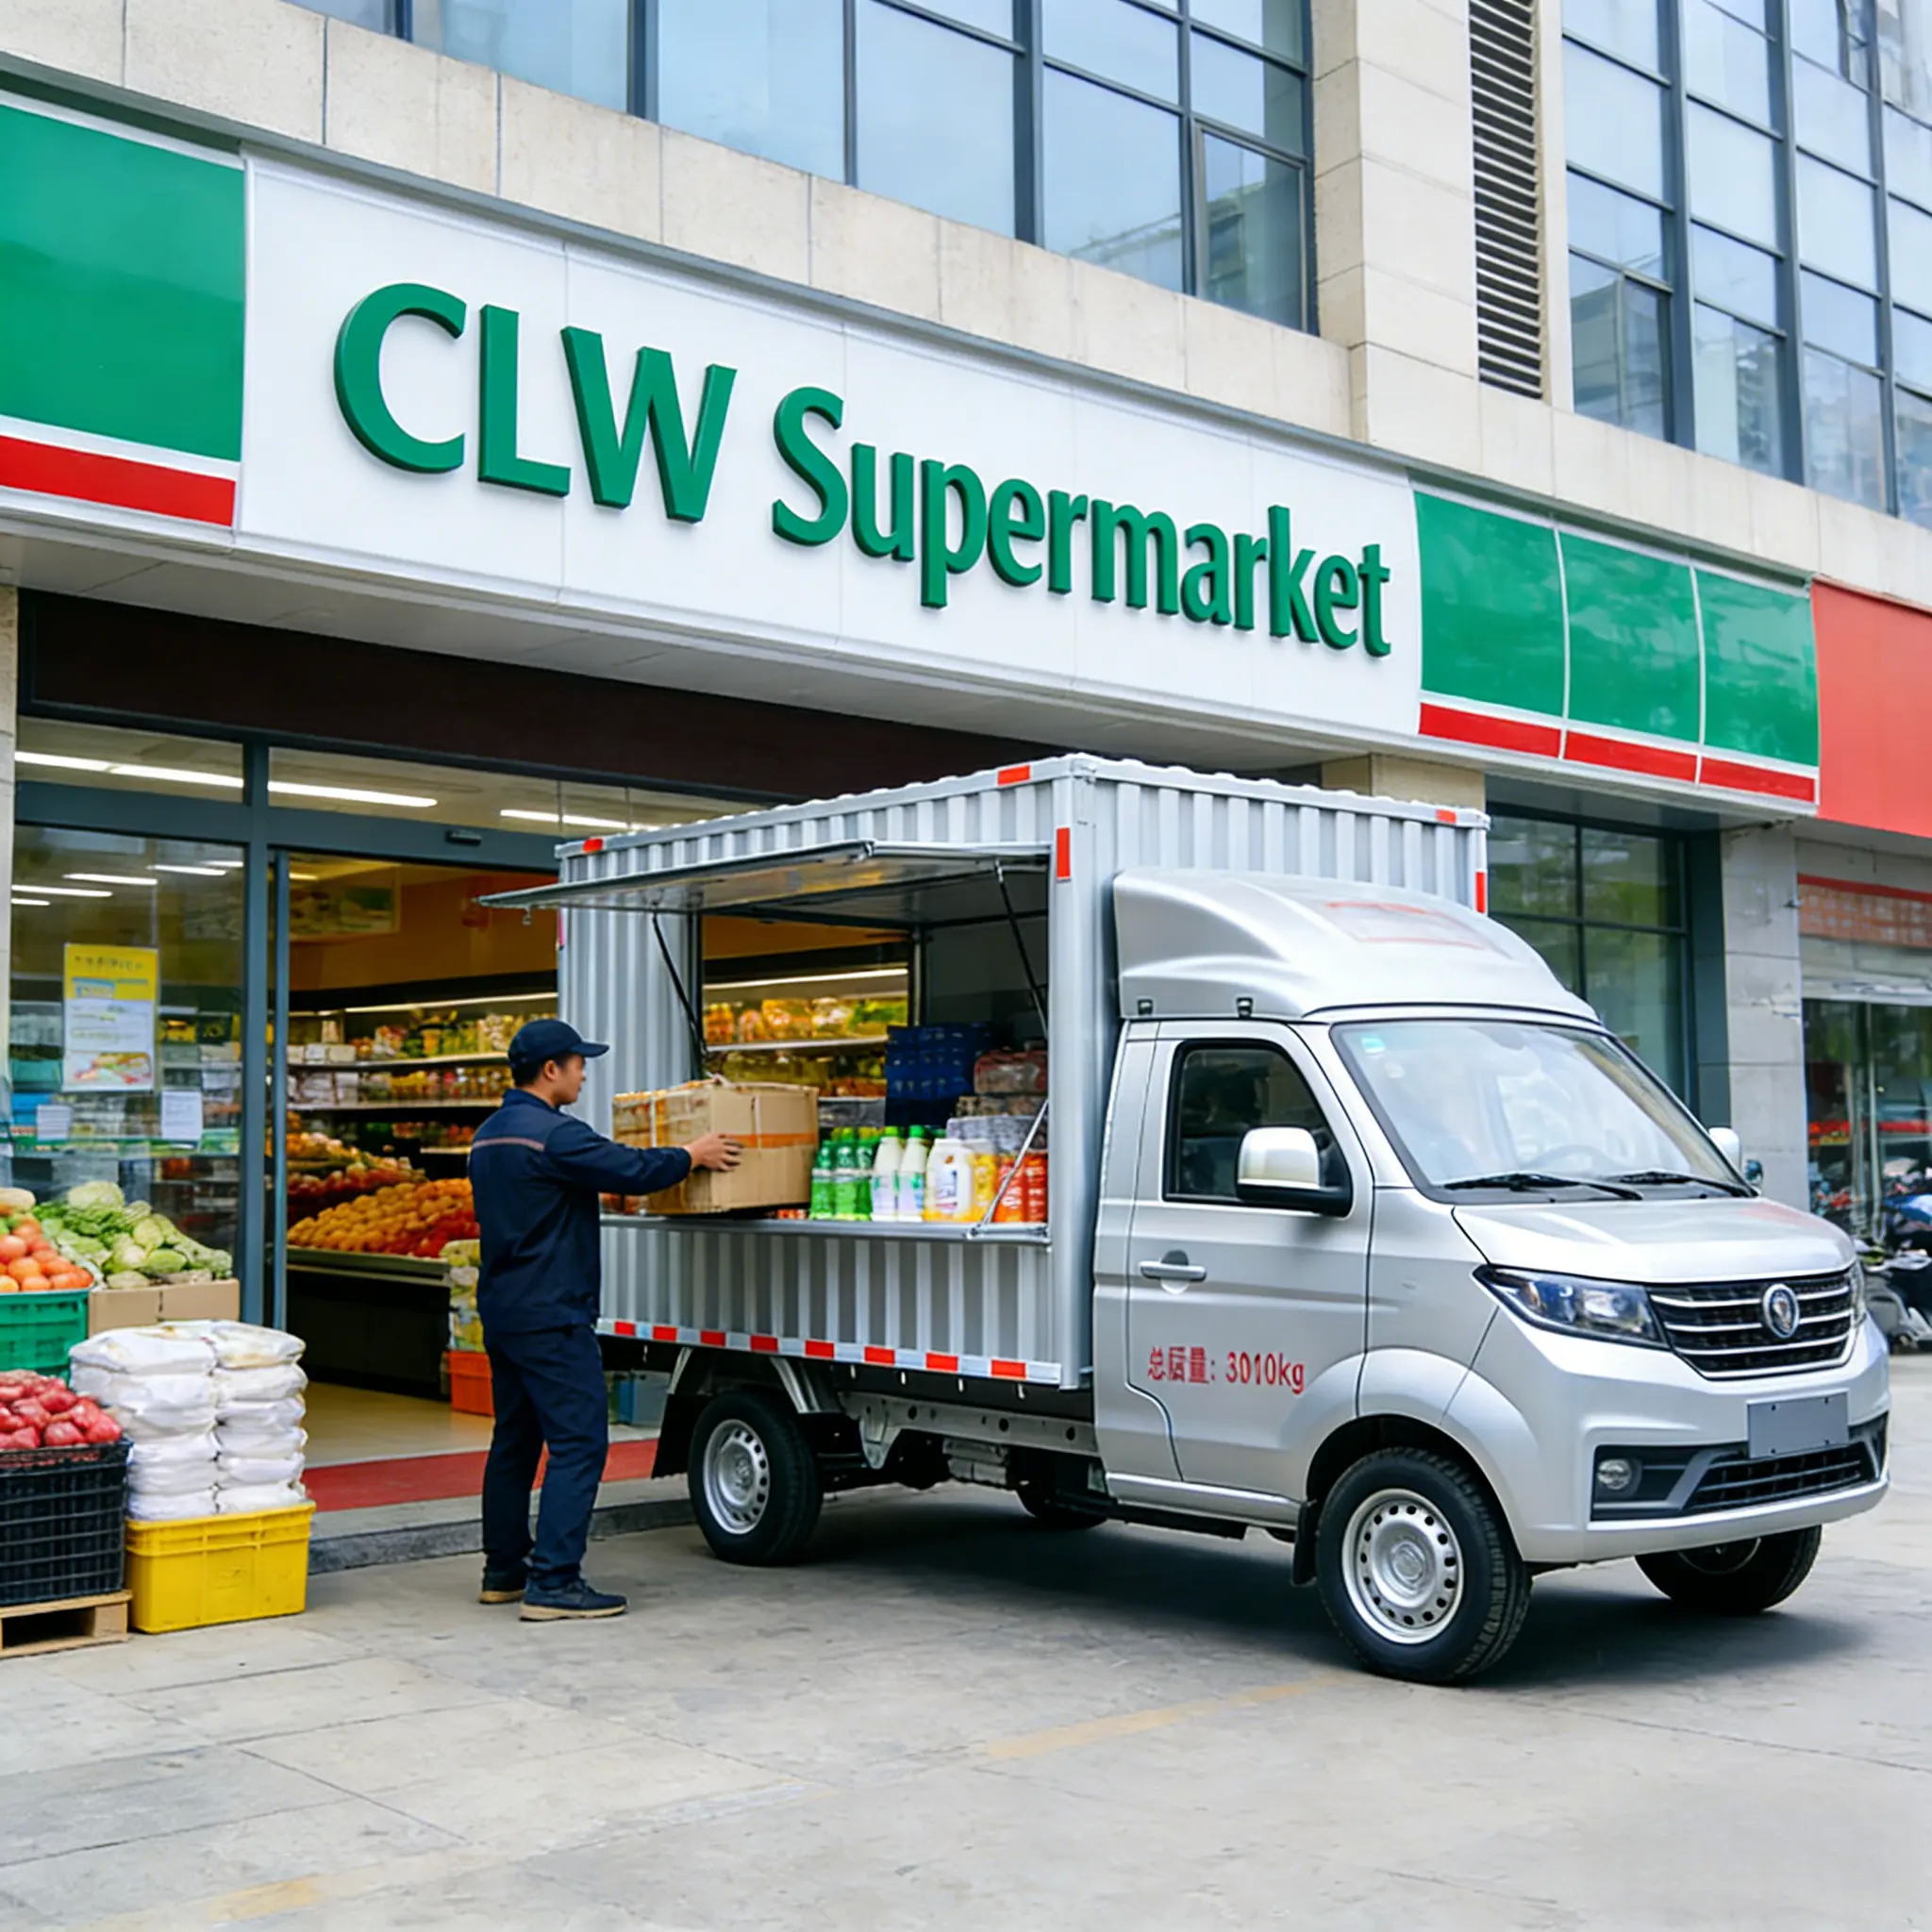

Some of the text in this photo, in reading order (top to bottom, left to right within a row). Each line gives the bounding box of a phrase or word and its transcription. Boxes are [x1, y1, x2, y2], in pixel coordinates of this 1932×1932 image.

[334, 282, 1392, 658] CLW Supermarket
[1225, 1350, 1305, 1395] 3010kg
